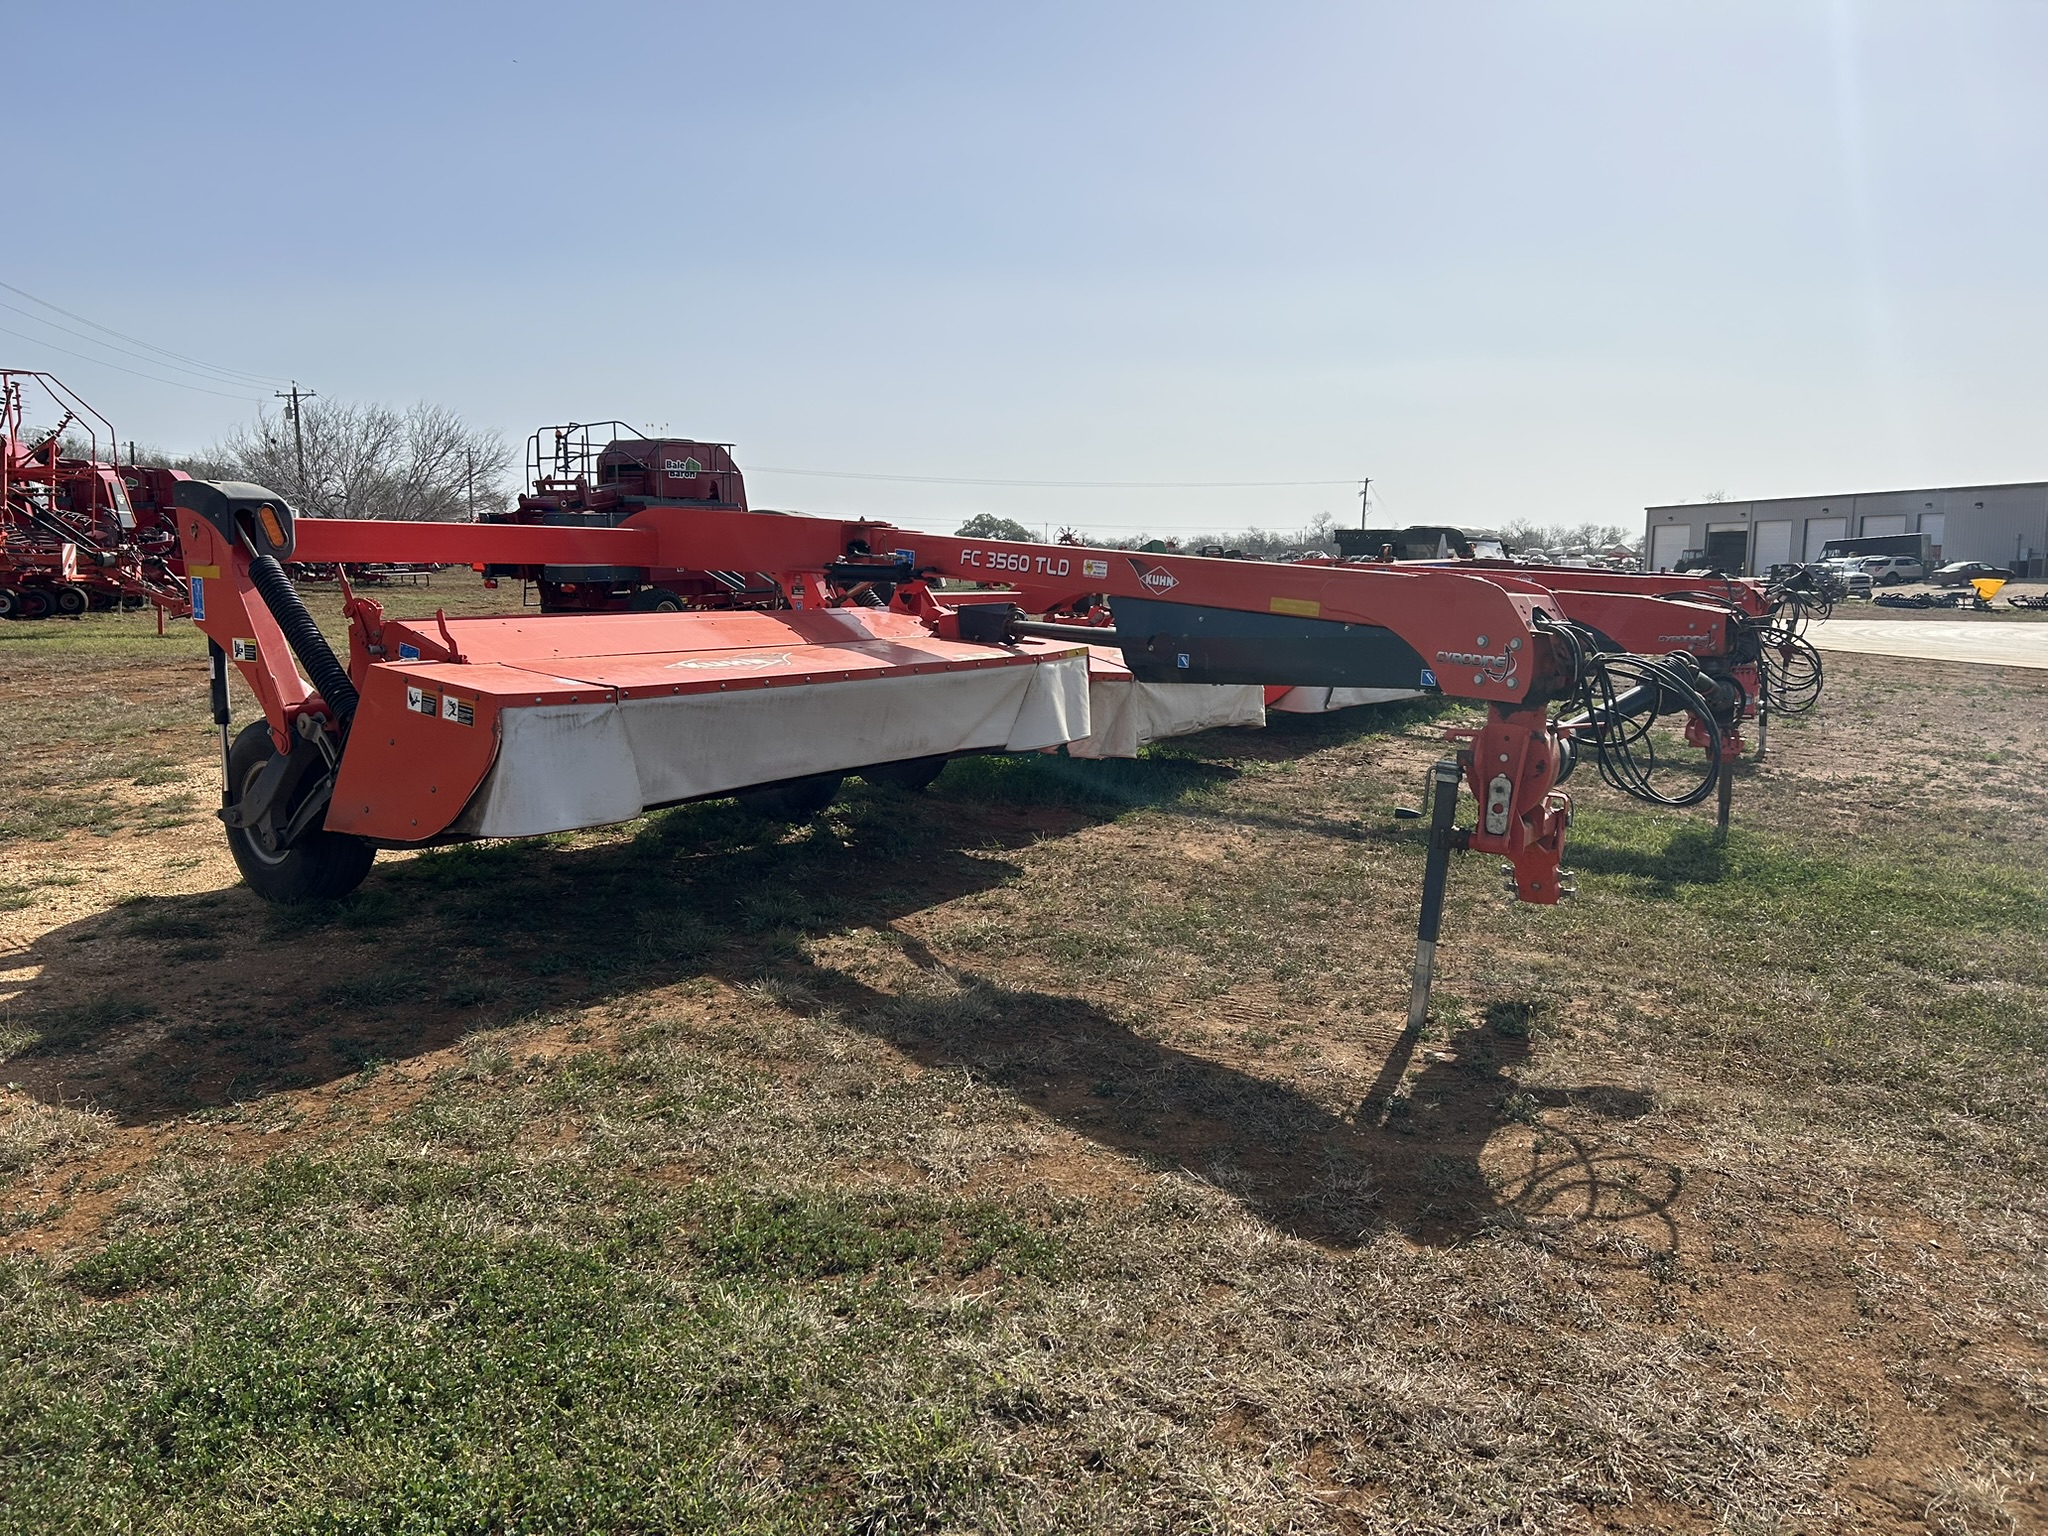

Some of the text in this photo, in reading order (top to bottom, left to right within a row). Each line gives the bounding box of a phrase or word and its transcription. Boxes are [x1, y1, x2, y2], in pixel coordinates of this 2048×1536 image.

[666, 460, 686, 470] Bale
[960, 549, 981, 567] FC
[985, 552, 1030, 573] 3560
[1035, 557, 1070, 577] TLD
[1145, 573, 1174, 587] KUHN
